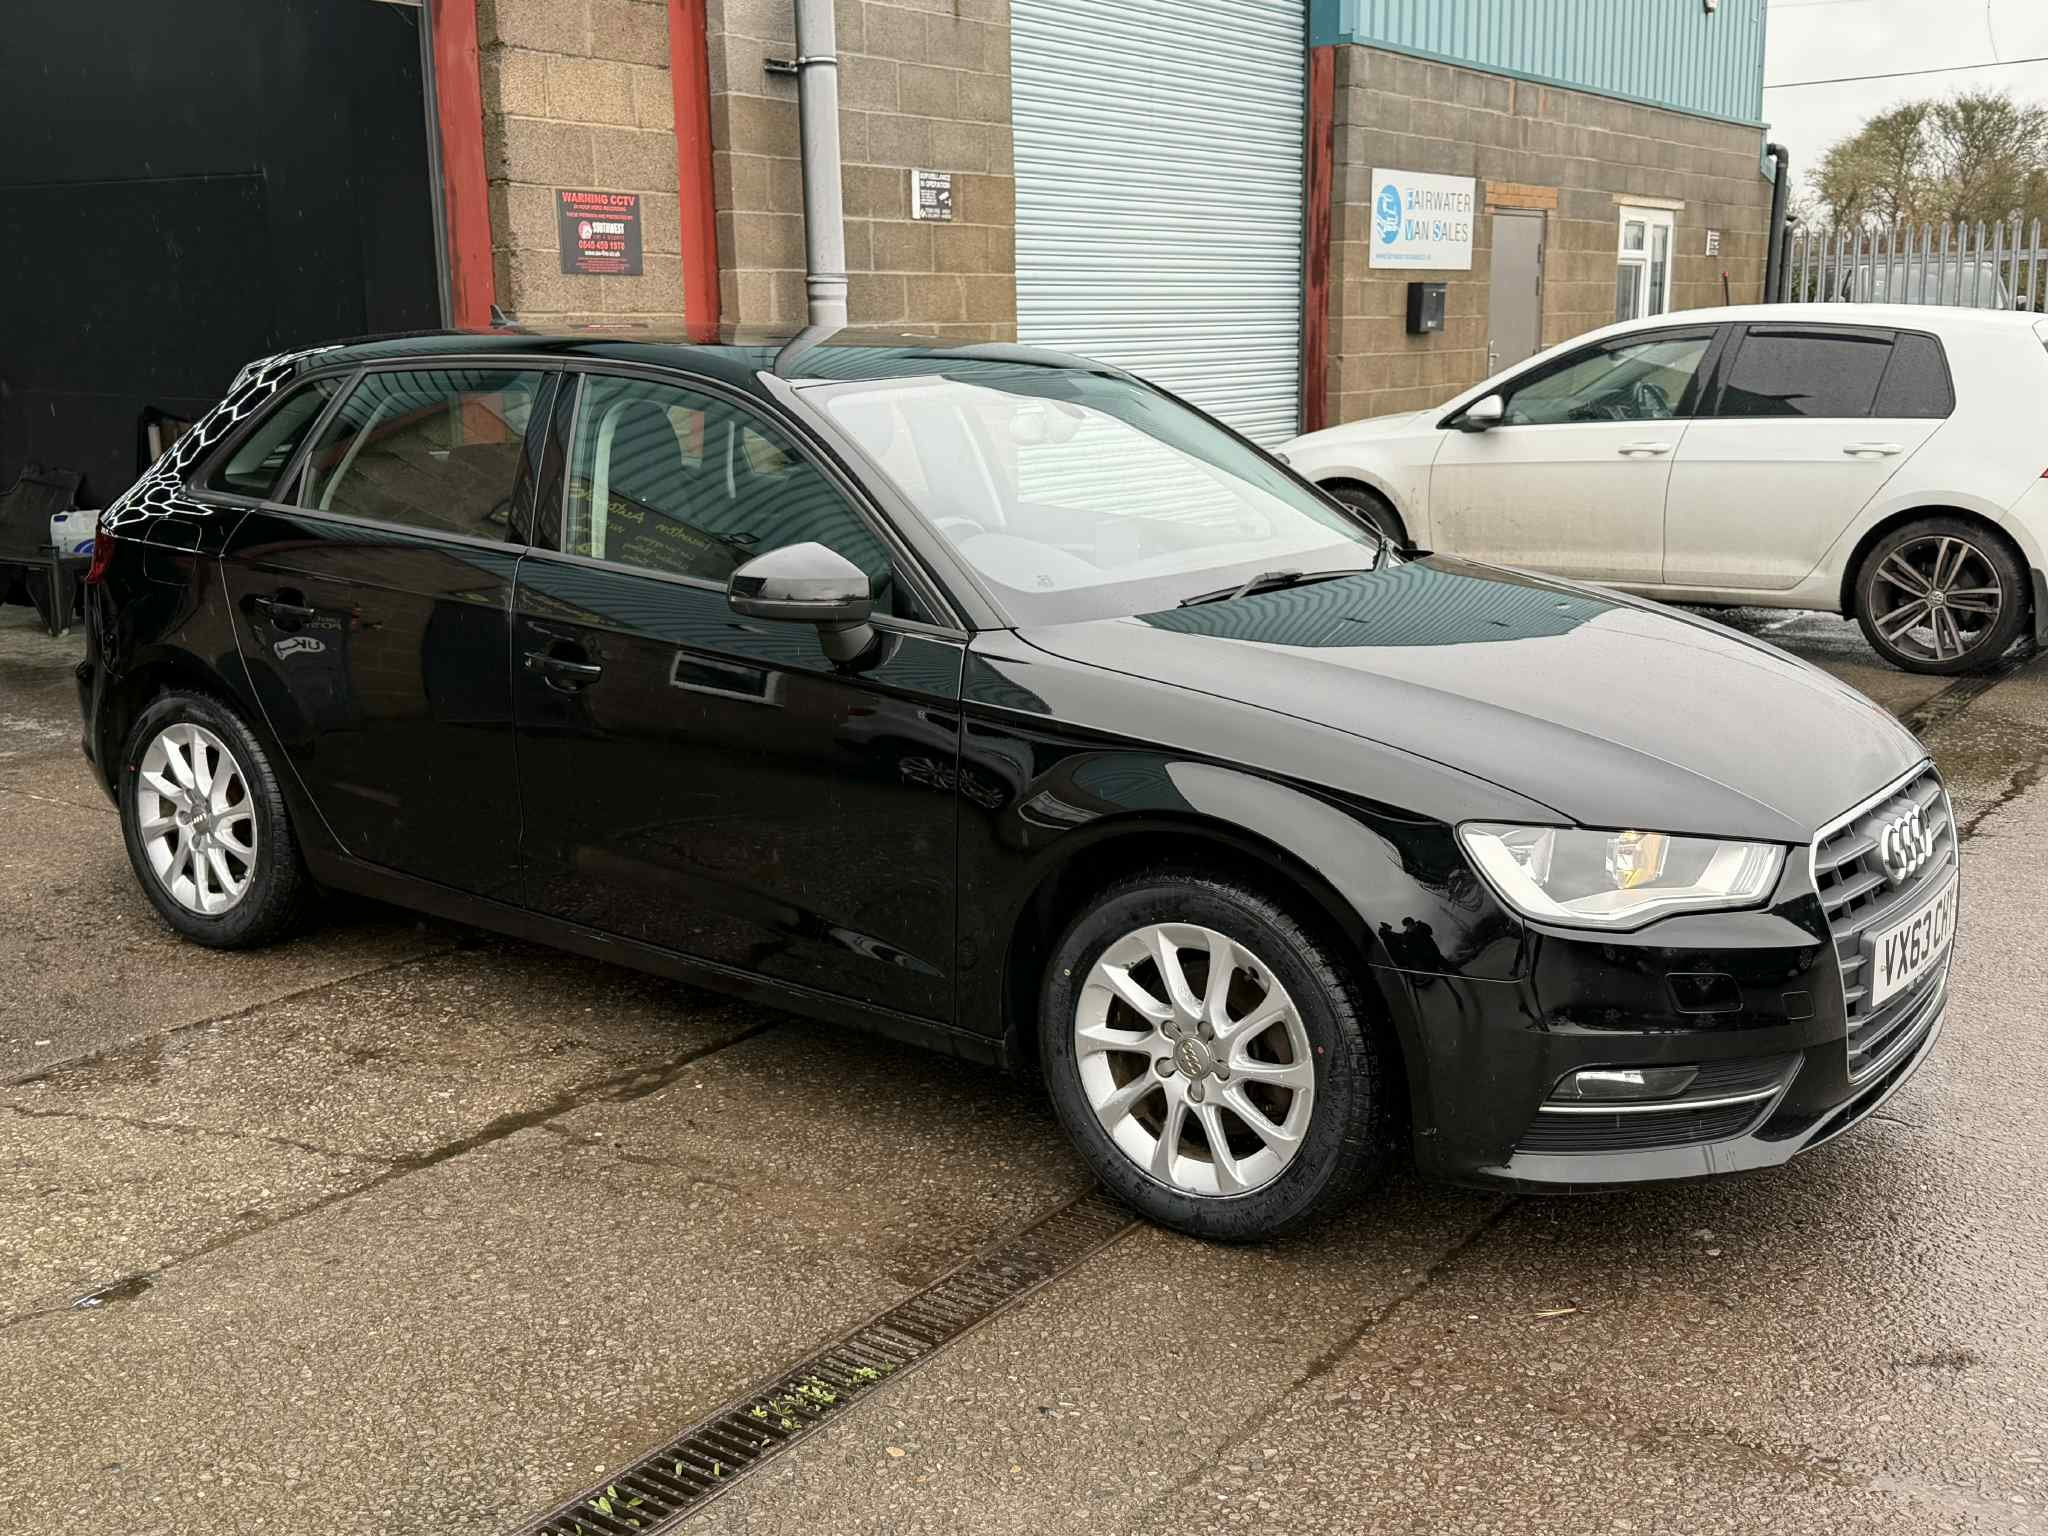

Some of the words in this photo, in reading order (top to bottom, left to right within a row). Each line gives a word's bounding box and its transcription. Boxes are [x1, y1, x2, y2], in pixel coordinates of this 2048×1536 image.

[562, 191, 609, 205] WARNING
[610, 195, 635, 206] CCTV
[1406, 190, 1471, 213] FAIRWATER
[1405, 219, 1429, 241] VAN
[1433, 222, 1469, 242] SALES
[1885, 910, 1932, 986] VX63
